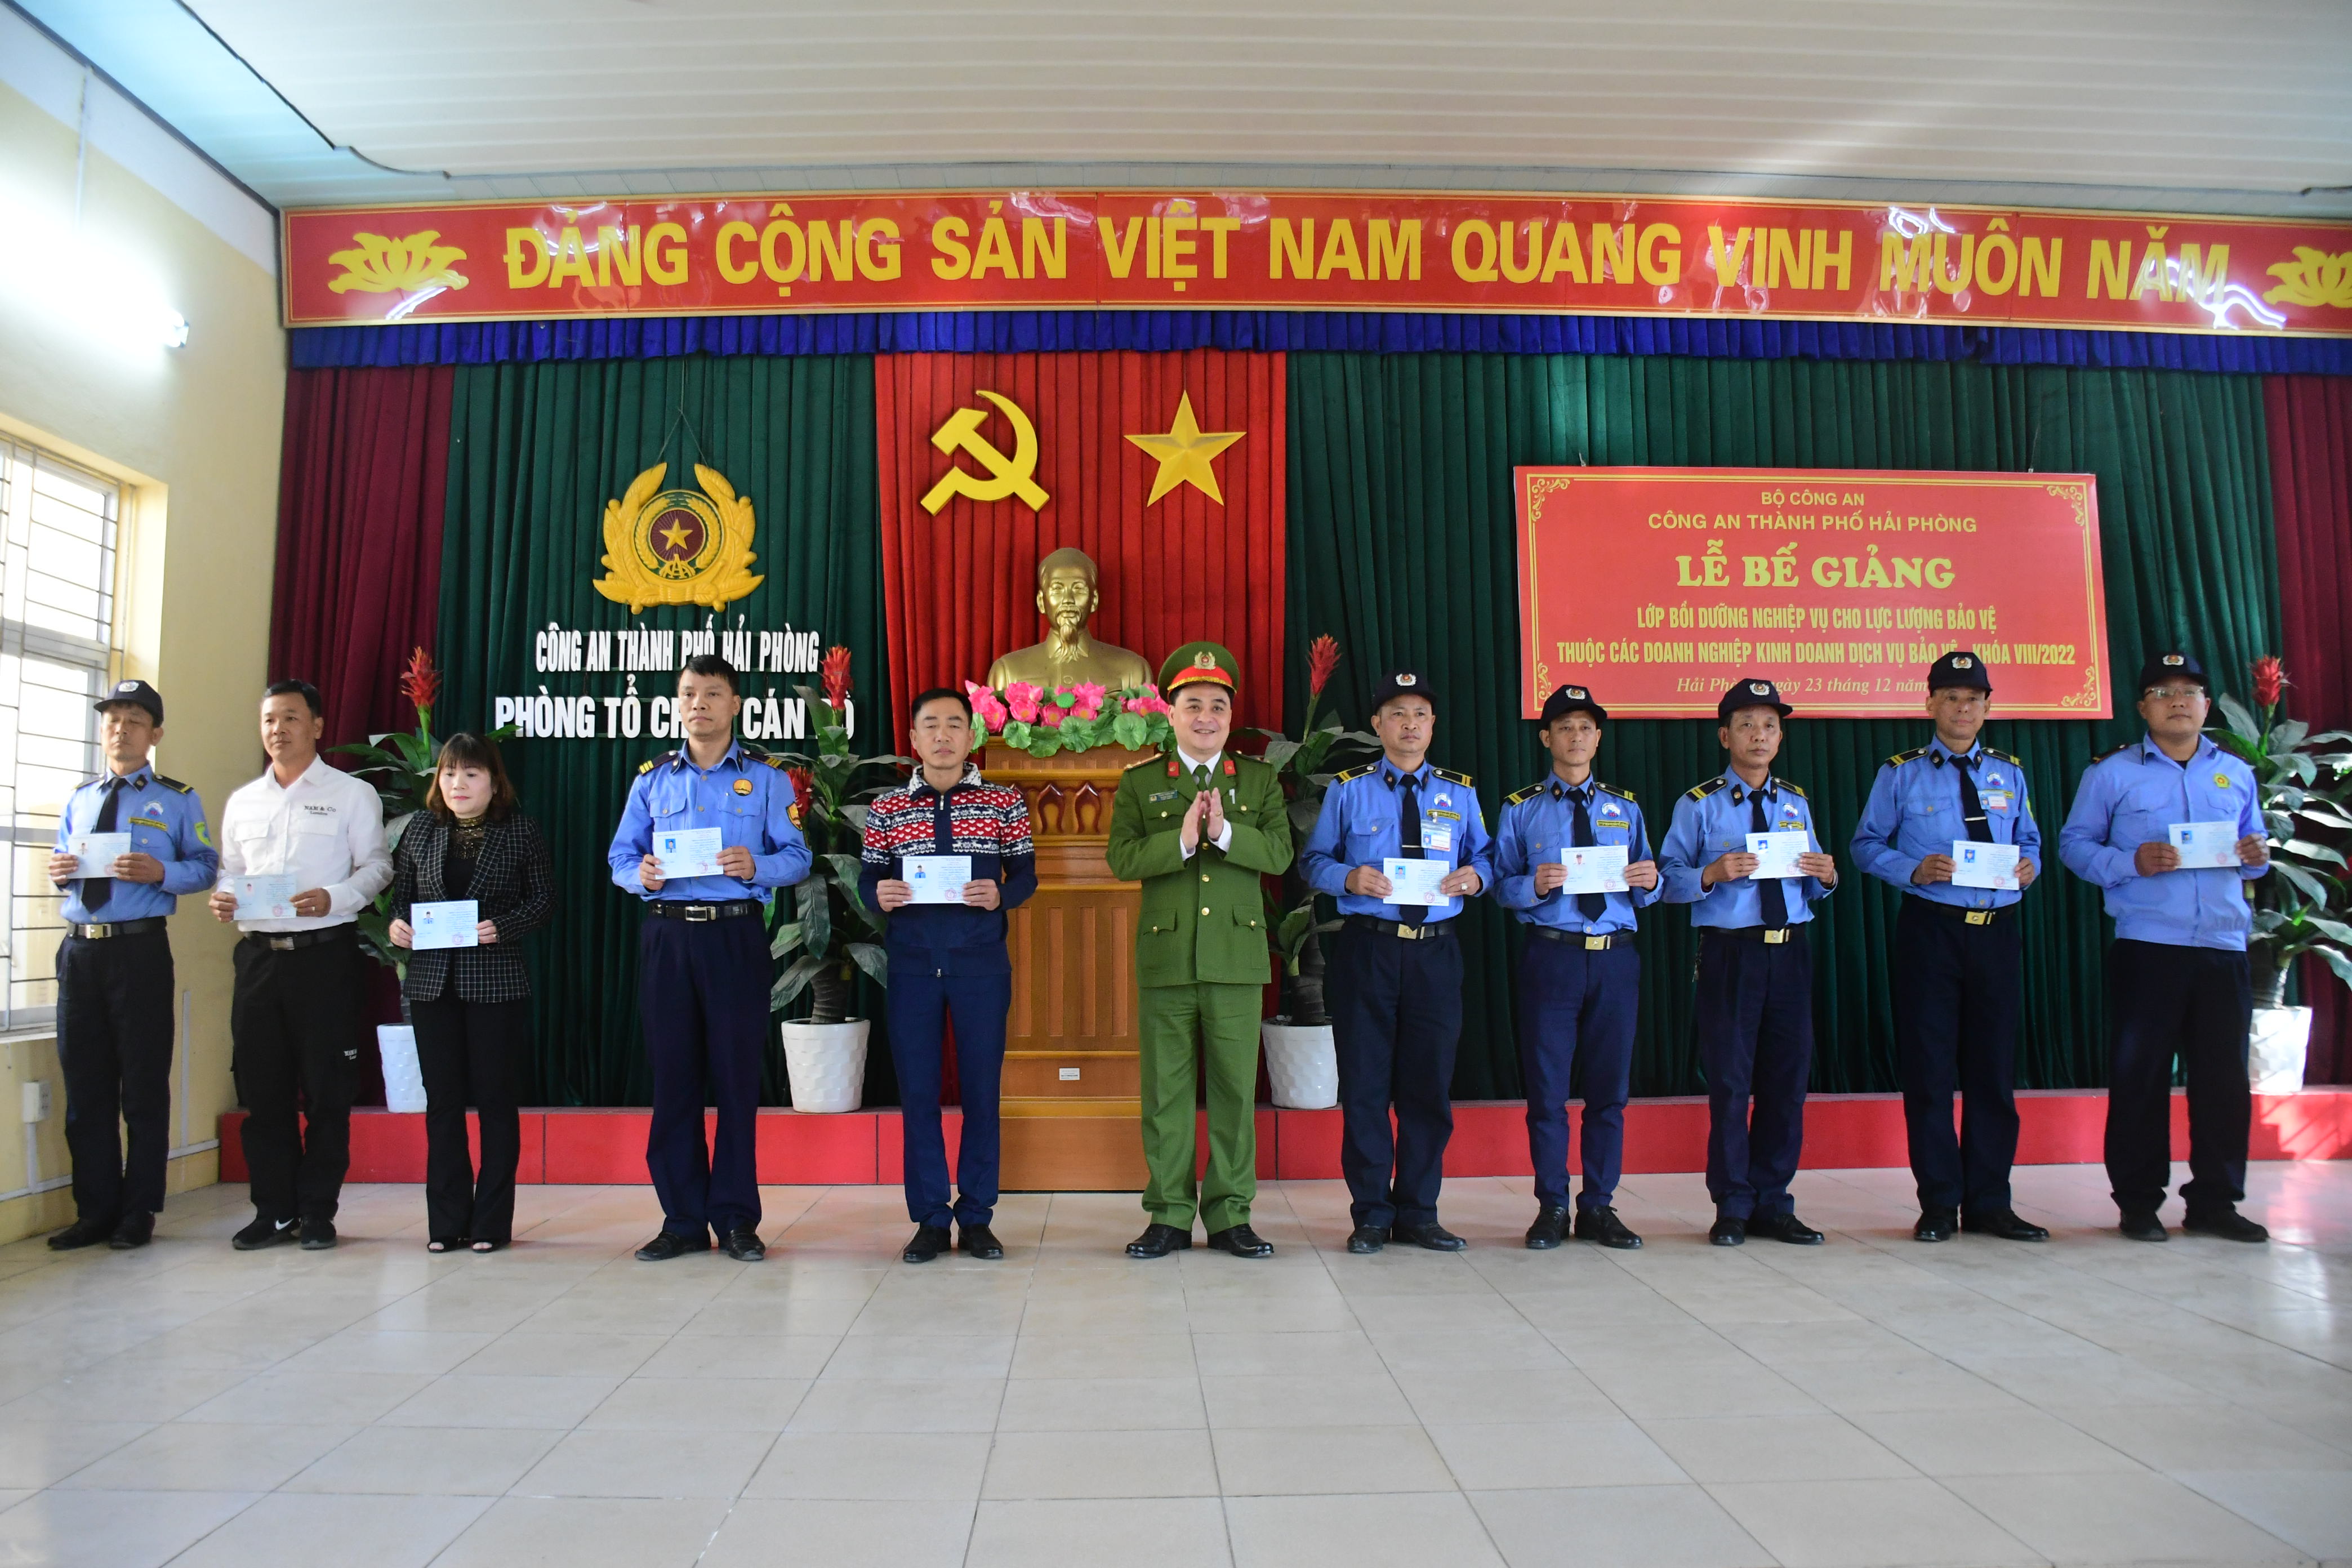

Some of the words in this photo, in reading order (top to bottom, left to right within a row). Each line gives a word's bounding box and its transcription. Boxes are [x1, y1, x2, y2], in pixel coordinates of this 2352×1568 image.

[503, 210, 689, 289] ĐẢNG
[715, 203, 901, 297] CỘNG
[931, 200, 1066, 280] SẢN
[1097, 201, 1240, 291] VIỆT
[1269, 217, 1421, 280] NAM
[1451, 219, 1681, 286] QUANG
[1707, 225, 1852, 290] VINH
[1879, 217, 2063, 297] MUÔN
[2087, 226, 2230, 303] NĂM
[1761, 489, 1785, 507] BỘ
[1789, 489, 1837, 506] CÔNG
[1842, 492, 1864, 506] AN
[1648, 510, 1707, 529] CÔNG
[1713, 515, 1740, 529] AN
[1747, 511, 1815, 531] THÀNH
[1822, 510, 1864, 531] PHỐ
[1869, 511, 1901, 532] HẢI
[1908, 514, 1977, 533] PHÒNG
[1675, 539, 1730, 587] LỄ
[1741, 542, 1799, 587] BẾ
[1811, 544, 1955, 589] GIẢNG
[1637, 603, 1665, 628] LỚP
[1669, 600, 1694, 629] BỒI
[1698, 603, 1748, 628] DƯỠNG
[1752, 603, 1805, 632] NGHIỆP
[1809, 608, 1828, 633] VỤ
[1832, 608, 1861, 629] CHO
[1865, 607, 1892, 633] LỰC
[1896, 607, 1943, 634] LƯỢNG
[1947, 603, 1975, 630] BẢO
[1979, 605, 1997, 634] VỆ
[536, 621, 582, 672] CÔNG
[586, 631, 611, 671] AN
[617, 621, 674, 671] THÀNH
[722, 613, 751, 672] HẢI
[759, 622, 819, 672] PHÒNG
[1557, 638, 1605, 667] THUỘC
[1609, 638, 1640, 663] CÁC
[1644, 642, 1694, 663] DOANH
[1698, 638, 1752, 667] NGHIỆP
[1756, 642, 1792, 663] KINH
[1795, 643, 1845, 663] DOANH
[1848, 643, 1882, 668] DỊCH
[1886, 643, 1905, 668] VỤ
[1909, 637, 1938, 663] BẢO
[1972, 639, 2011, 664] KHÓA
[2013, 644, 2076, 665] VIII/2022
[1676, 677, 1704, 692] Hải
[1709, 677, 1738, 692] Phò
[1771, 678, 1801, 696] gày
[1805, 678, 1823, 692] 23
[1827, 678, 1870, 695] tháng
[1874, 679, 1891, 693] 12
[1896, 680, 1927, 693] năm
[495, 684, 596, 738] PHÒNG
[604, 673, 642, 738] TỔ
[650, 696, 691, 739] CH
[742, 688, 805, 740] CÁN
